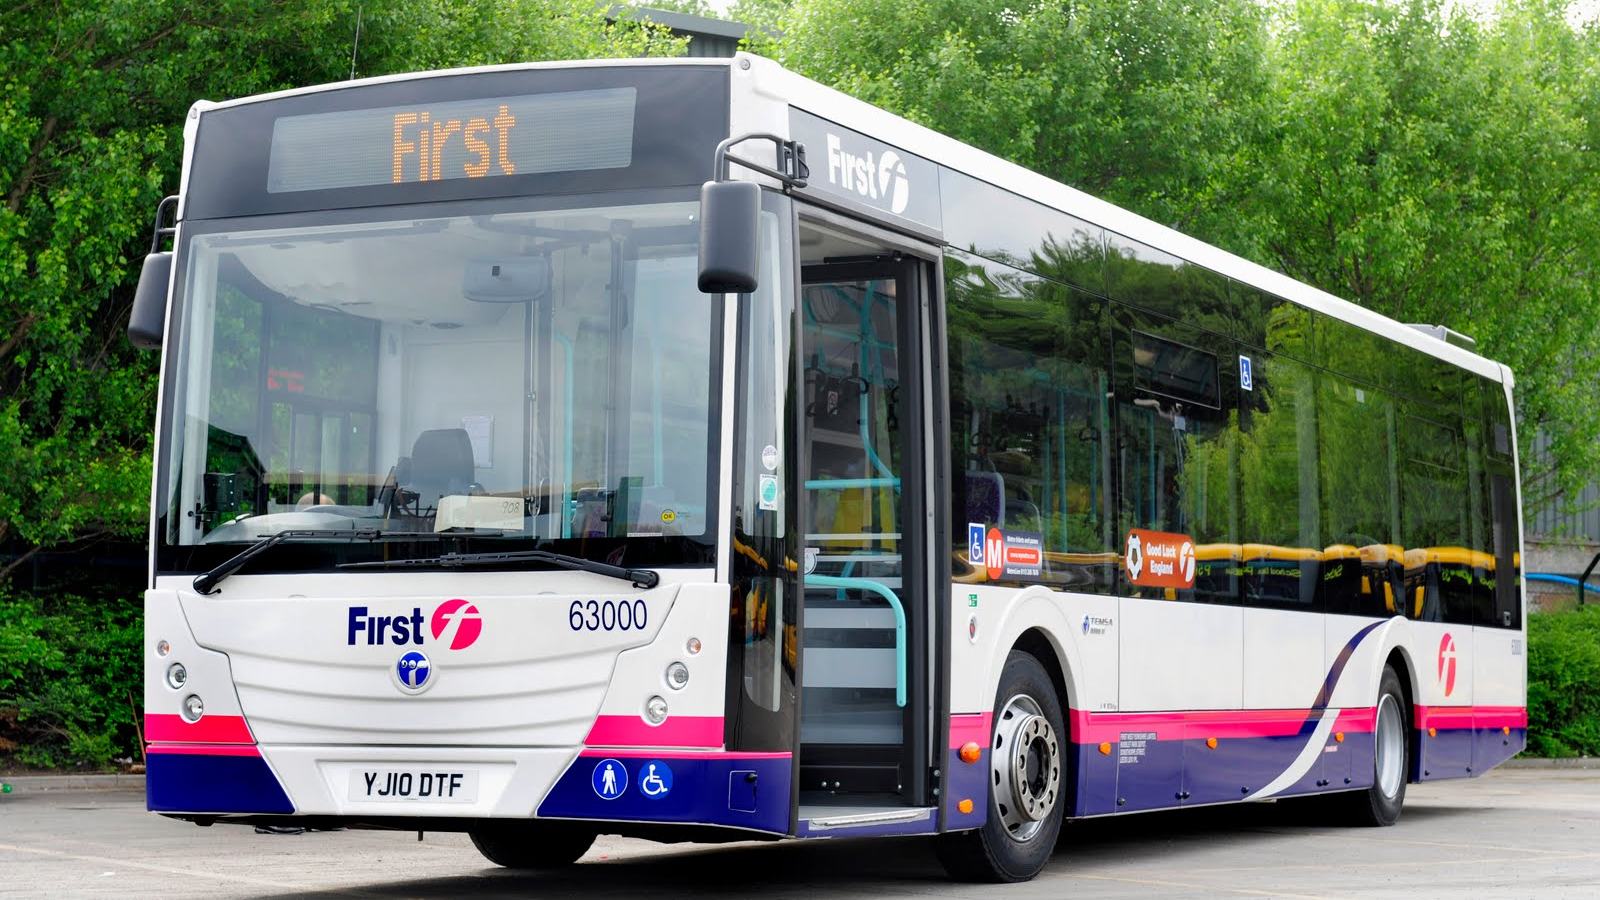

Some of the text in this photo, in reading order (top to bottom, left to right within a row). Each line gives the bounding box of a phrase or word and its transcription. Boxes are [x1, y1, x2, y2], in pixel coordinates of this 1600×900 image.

[394, 105, 515, 183] First
[827, 132, 877, 199] First
[987, 538, 1002, 569] M
[1146, 542, 1161, 556] Good
[1162, 544, 1176, 558] Luck
[1150, 559, 1173, 576] England
[348, 606, 424, 646] First
[569, 599, 647, 631] 63000
[364, 772, 464, 797] YJ10 DTF
